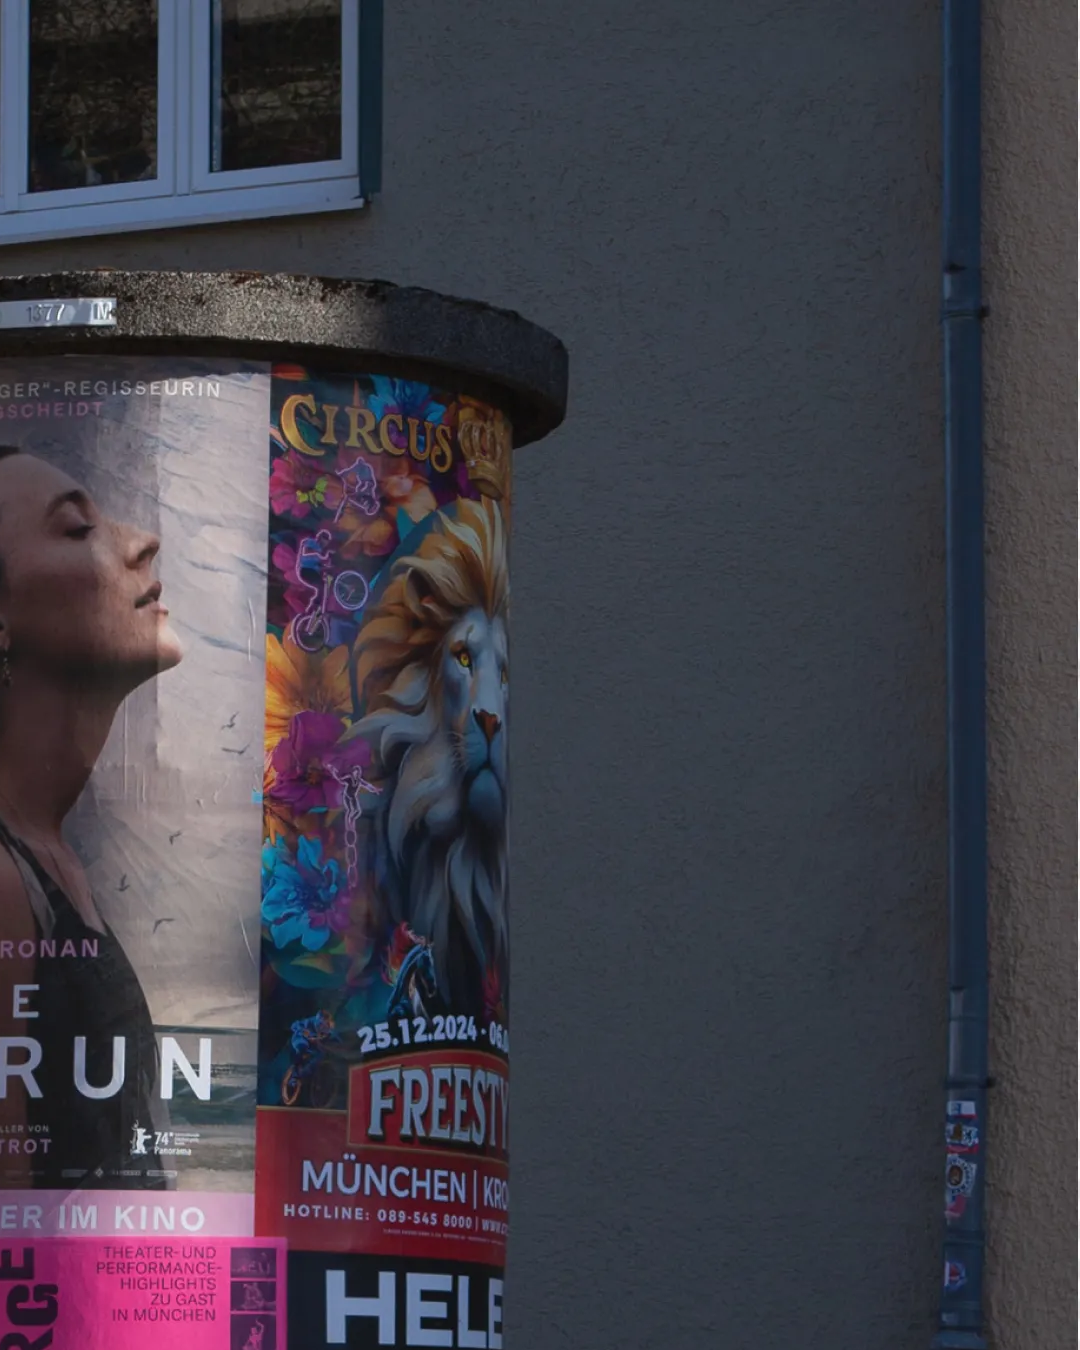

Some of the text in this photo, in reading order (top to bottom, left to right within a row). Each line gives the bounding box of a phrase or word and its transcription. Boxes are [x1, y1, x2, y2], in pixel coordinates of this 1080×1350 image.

[280, 393, 453, 473] CIRCUS
[0, 938, 99, 958] RONAN
[357, 1015, 478, 1053] 25.12.2024
[28, 1123, 50, 1133] VON
[302, 1153, 467, 1204] MÜNCHEN
[58, 1205, 98, 1229] IM
[115, 1205, 206, 1232] KINO
[283, 1203, 371, 1221] HOTLINE:
[377, 1208, 438, 1226] 089-545
[443, 1213, 472, 1230] 8000
[182, 1245, 217, 1259] UND
[96, 1261, 222, 1275] PERFORMANCE-
[120, 1277, 217, 1291] HIGHLIGHTS
[150, 1293, 217, 1306] ZU GAST
[112, 1306, 217, 1322] IN MÜNCHEN
